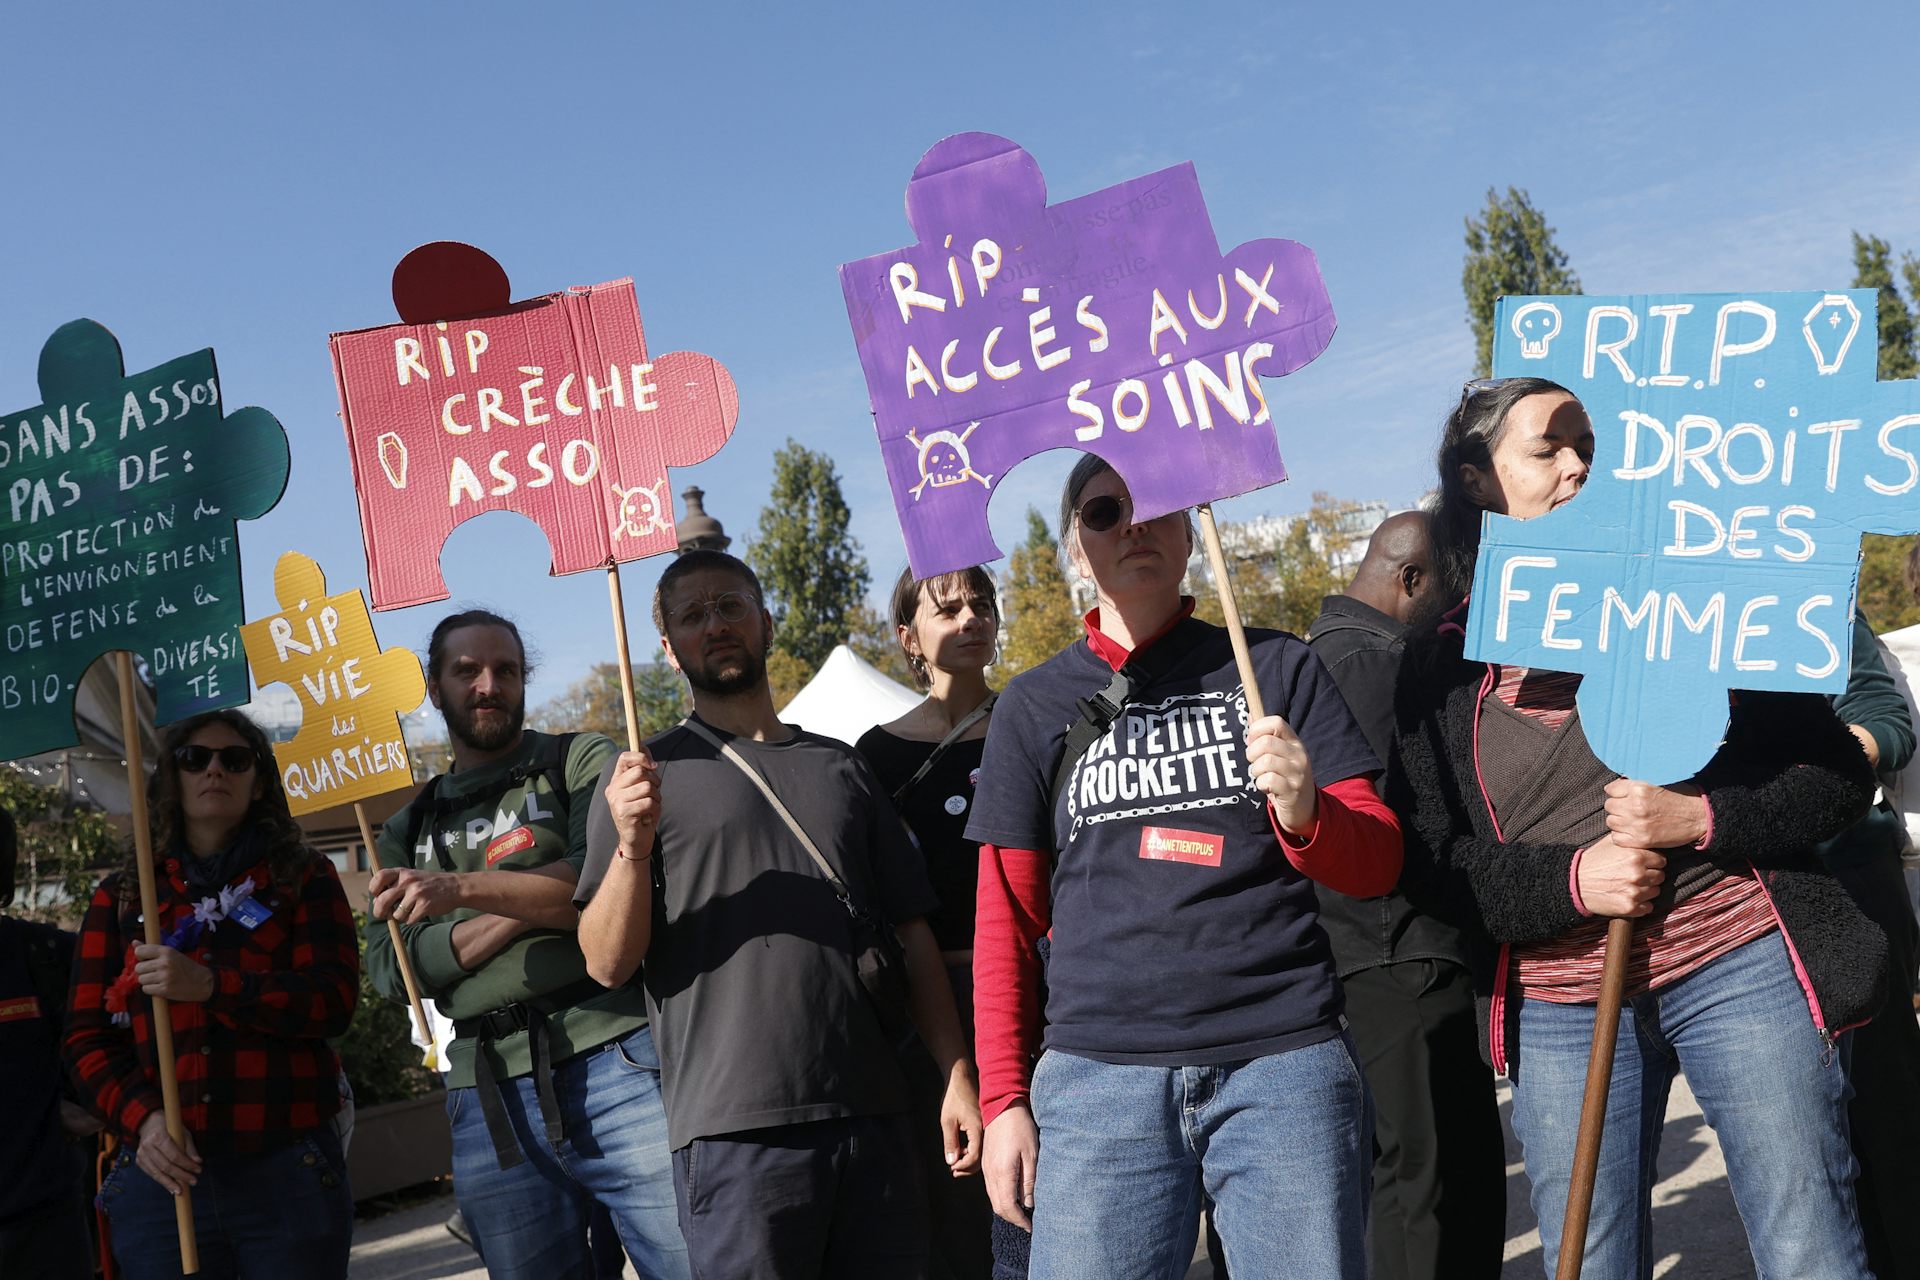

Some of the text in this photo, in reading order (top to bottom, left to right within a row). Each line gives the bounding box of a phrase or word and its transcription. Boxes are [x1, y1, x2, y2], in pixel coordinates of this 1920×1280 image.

[905, 262, 1279, 399] ACCÈS AUX
[1583, 301, 1776, 389] R.I.P.
[441, 362, 659, 435] CRÈCHE
[1067, 342, 1273, 441] SOINS
[0, 402, 96, 468] SANS
[9, 470, 81, 523] PAS
[449, 440, 598, 507] ASSO
[1663, 500, 1816, 562] DES
[7, 599, 139, 652] DEFENSE
[1496, 556, 1840, 678] FEMMES
[187, 666, 220, 699] TÉ
[331, 715, 357, 737] des
[1085, 706, 1233, 765] LA PETITE
[283, 736, 406, 800] QUARTIERS
[1080, 743, 1243, 809] ROCKETTE
